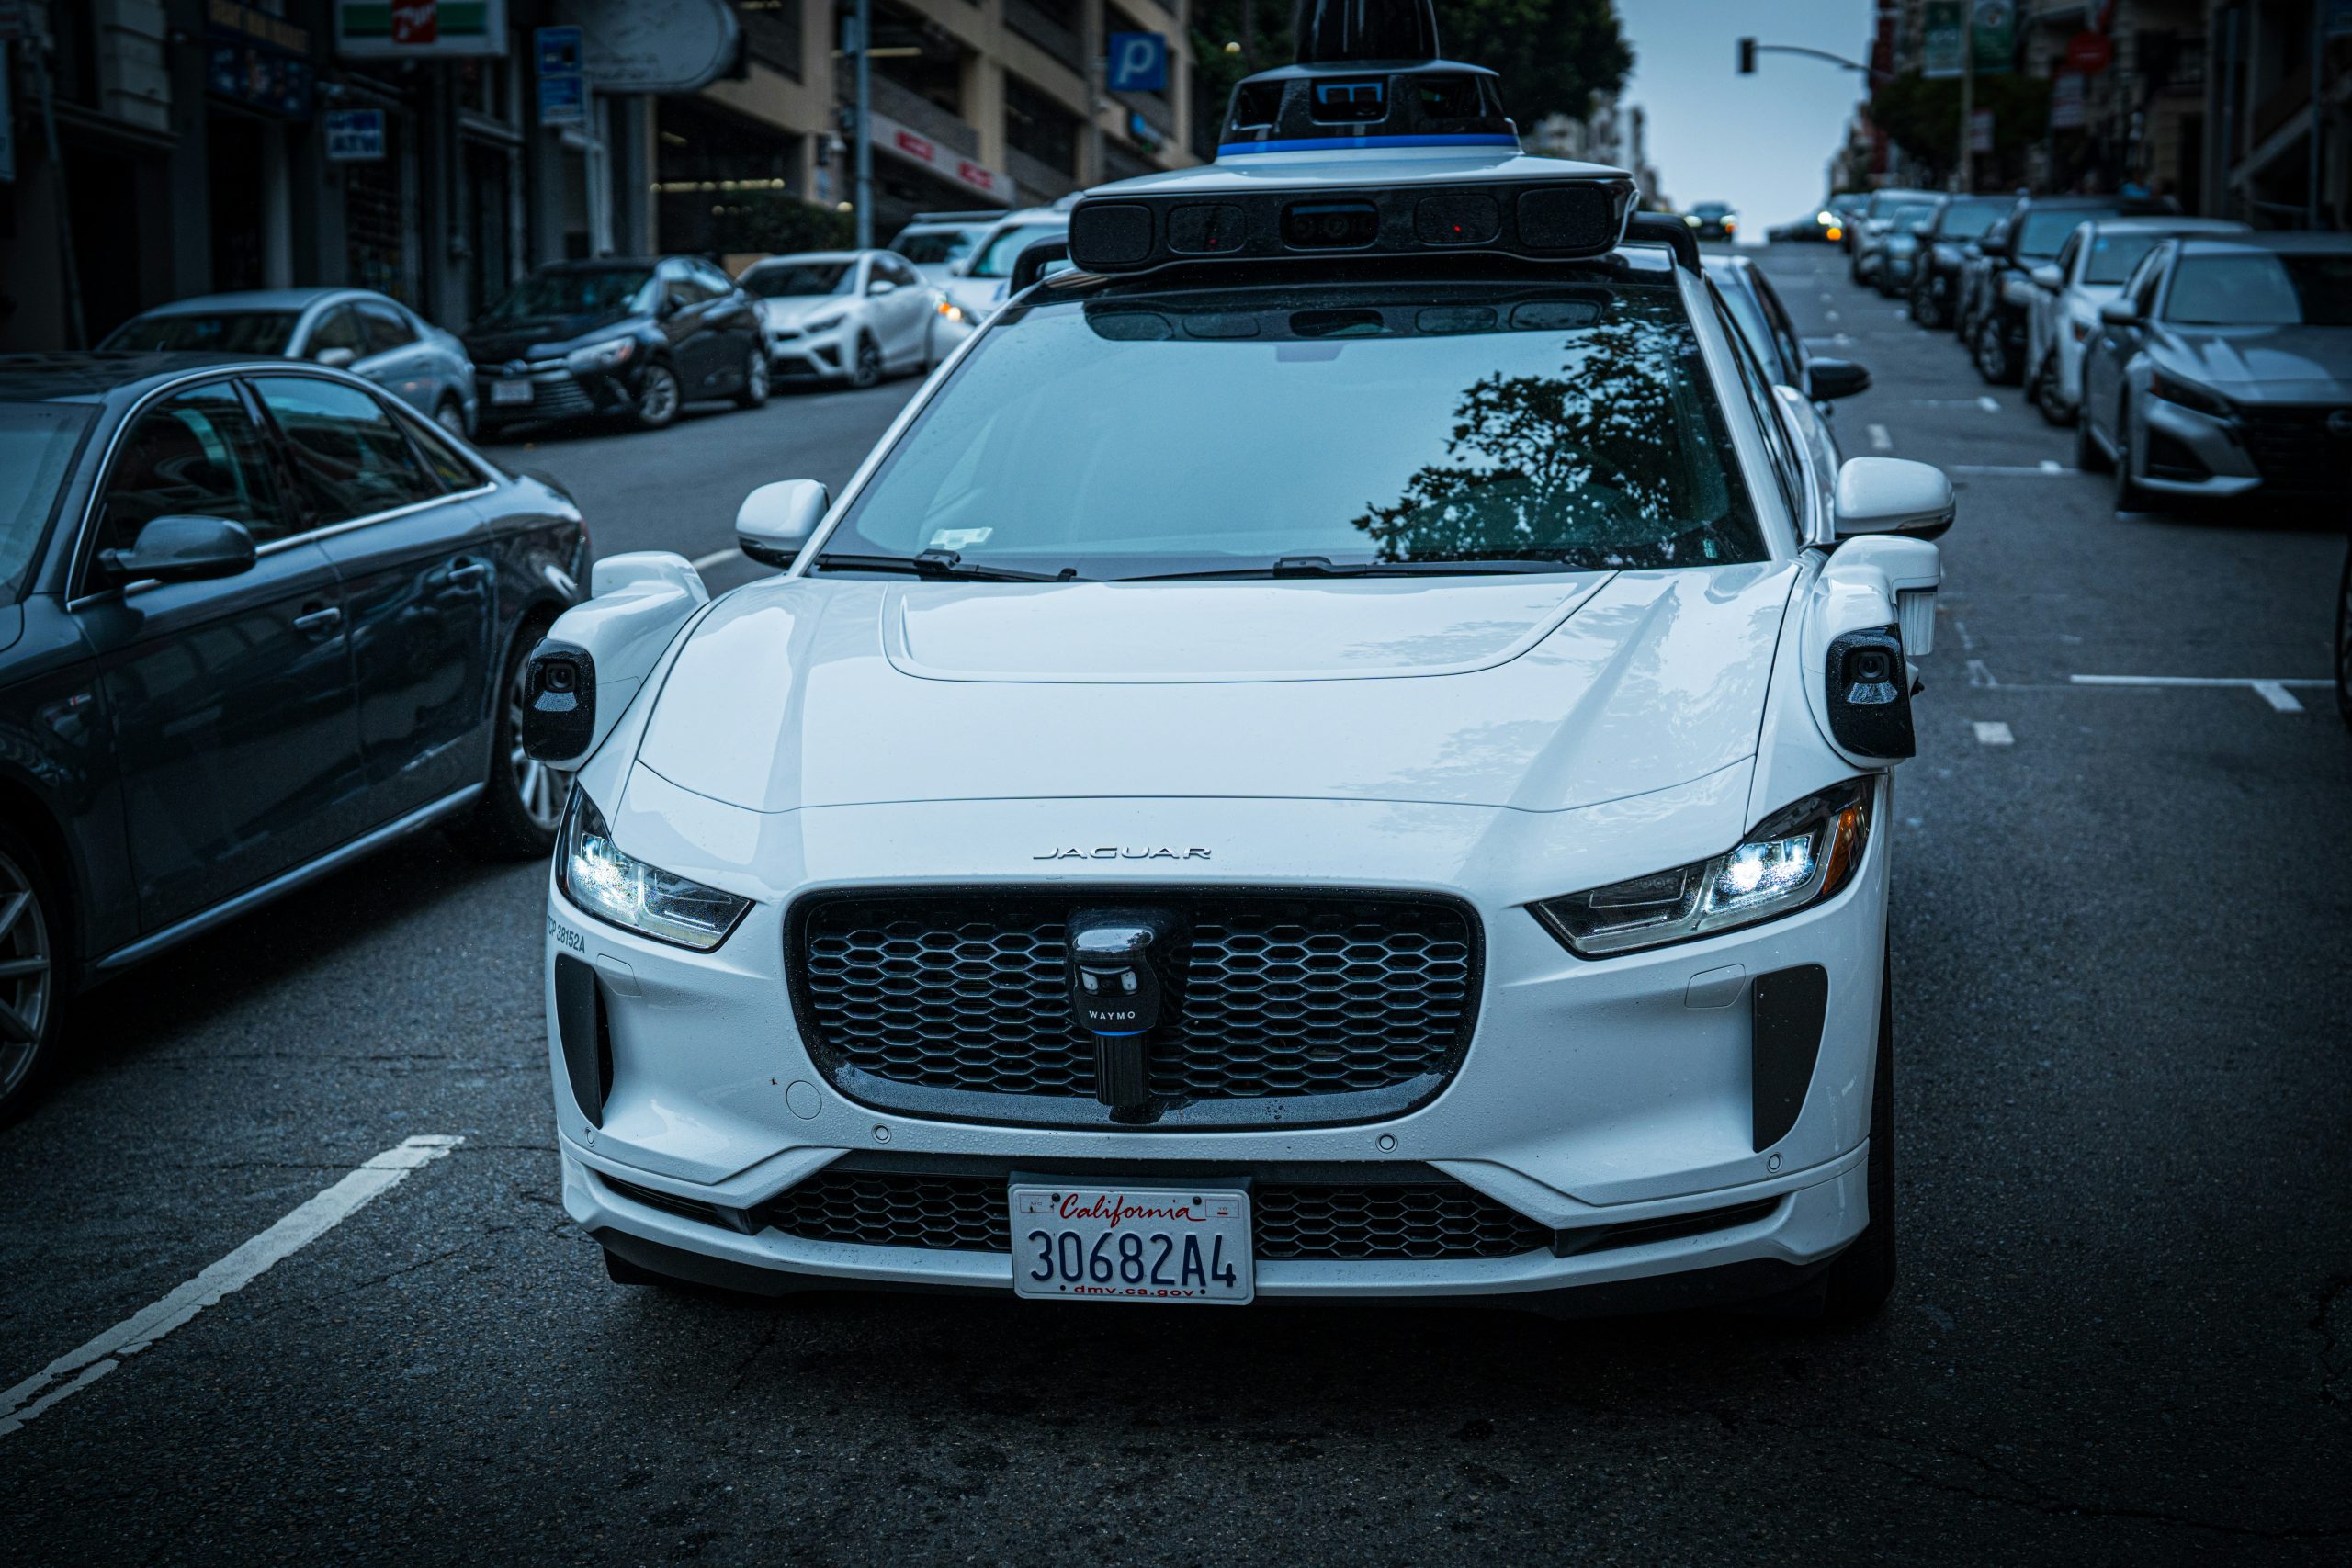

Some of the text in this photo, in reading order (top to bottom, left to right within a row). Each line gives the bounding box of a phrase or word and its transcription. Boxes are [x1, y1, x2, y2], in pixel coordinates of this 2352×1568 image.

[1033, 846, 1212, 860] JAGUAR
[556, 924, 585, 954] 38152A
[1089, 1010, 1136, 1021] WAYMO
[1059, 1193, 1206, 1228] California
[1028, 1230, 1237, 1288] 30682A4
[1074, 1285, 1194, 1297] dmv.ca.gov
